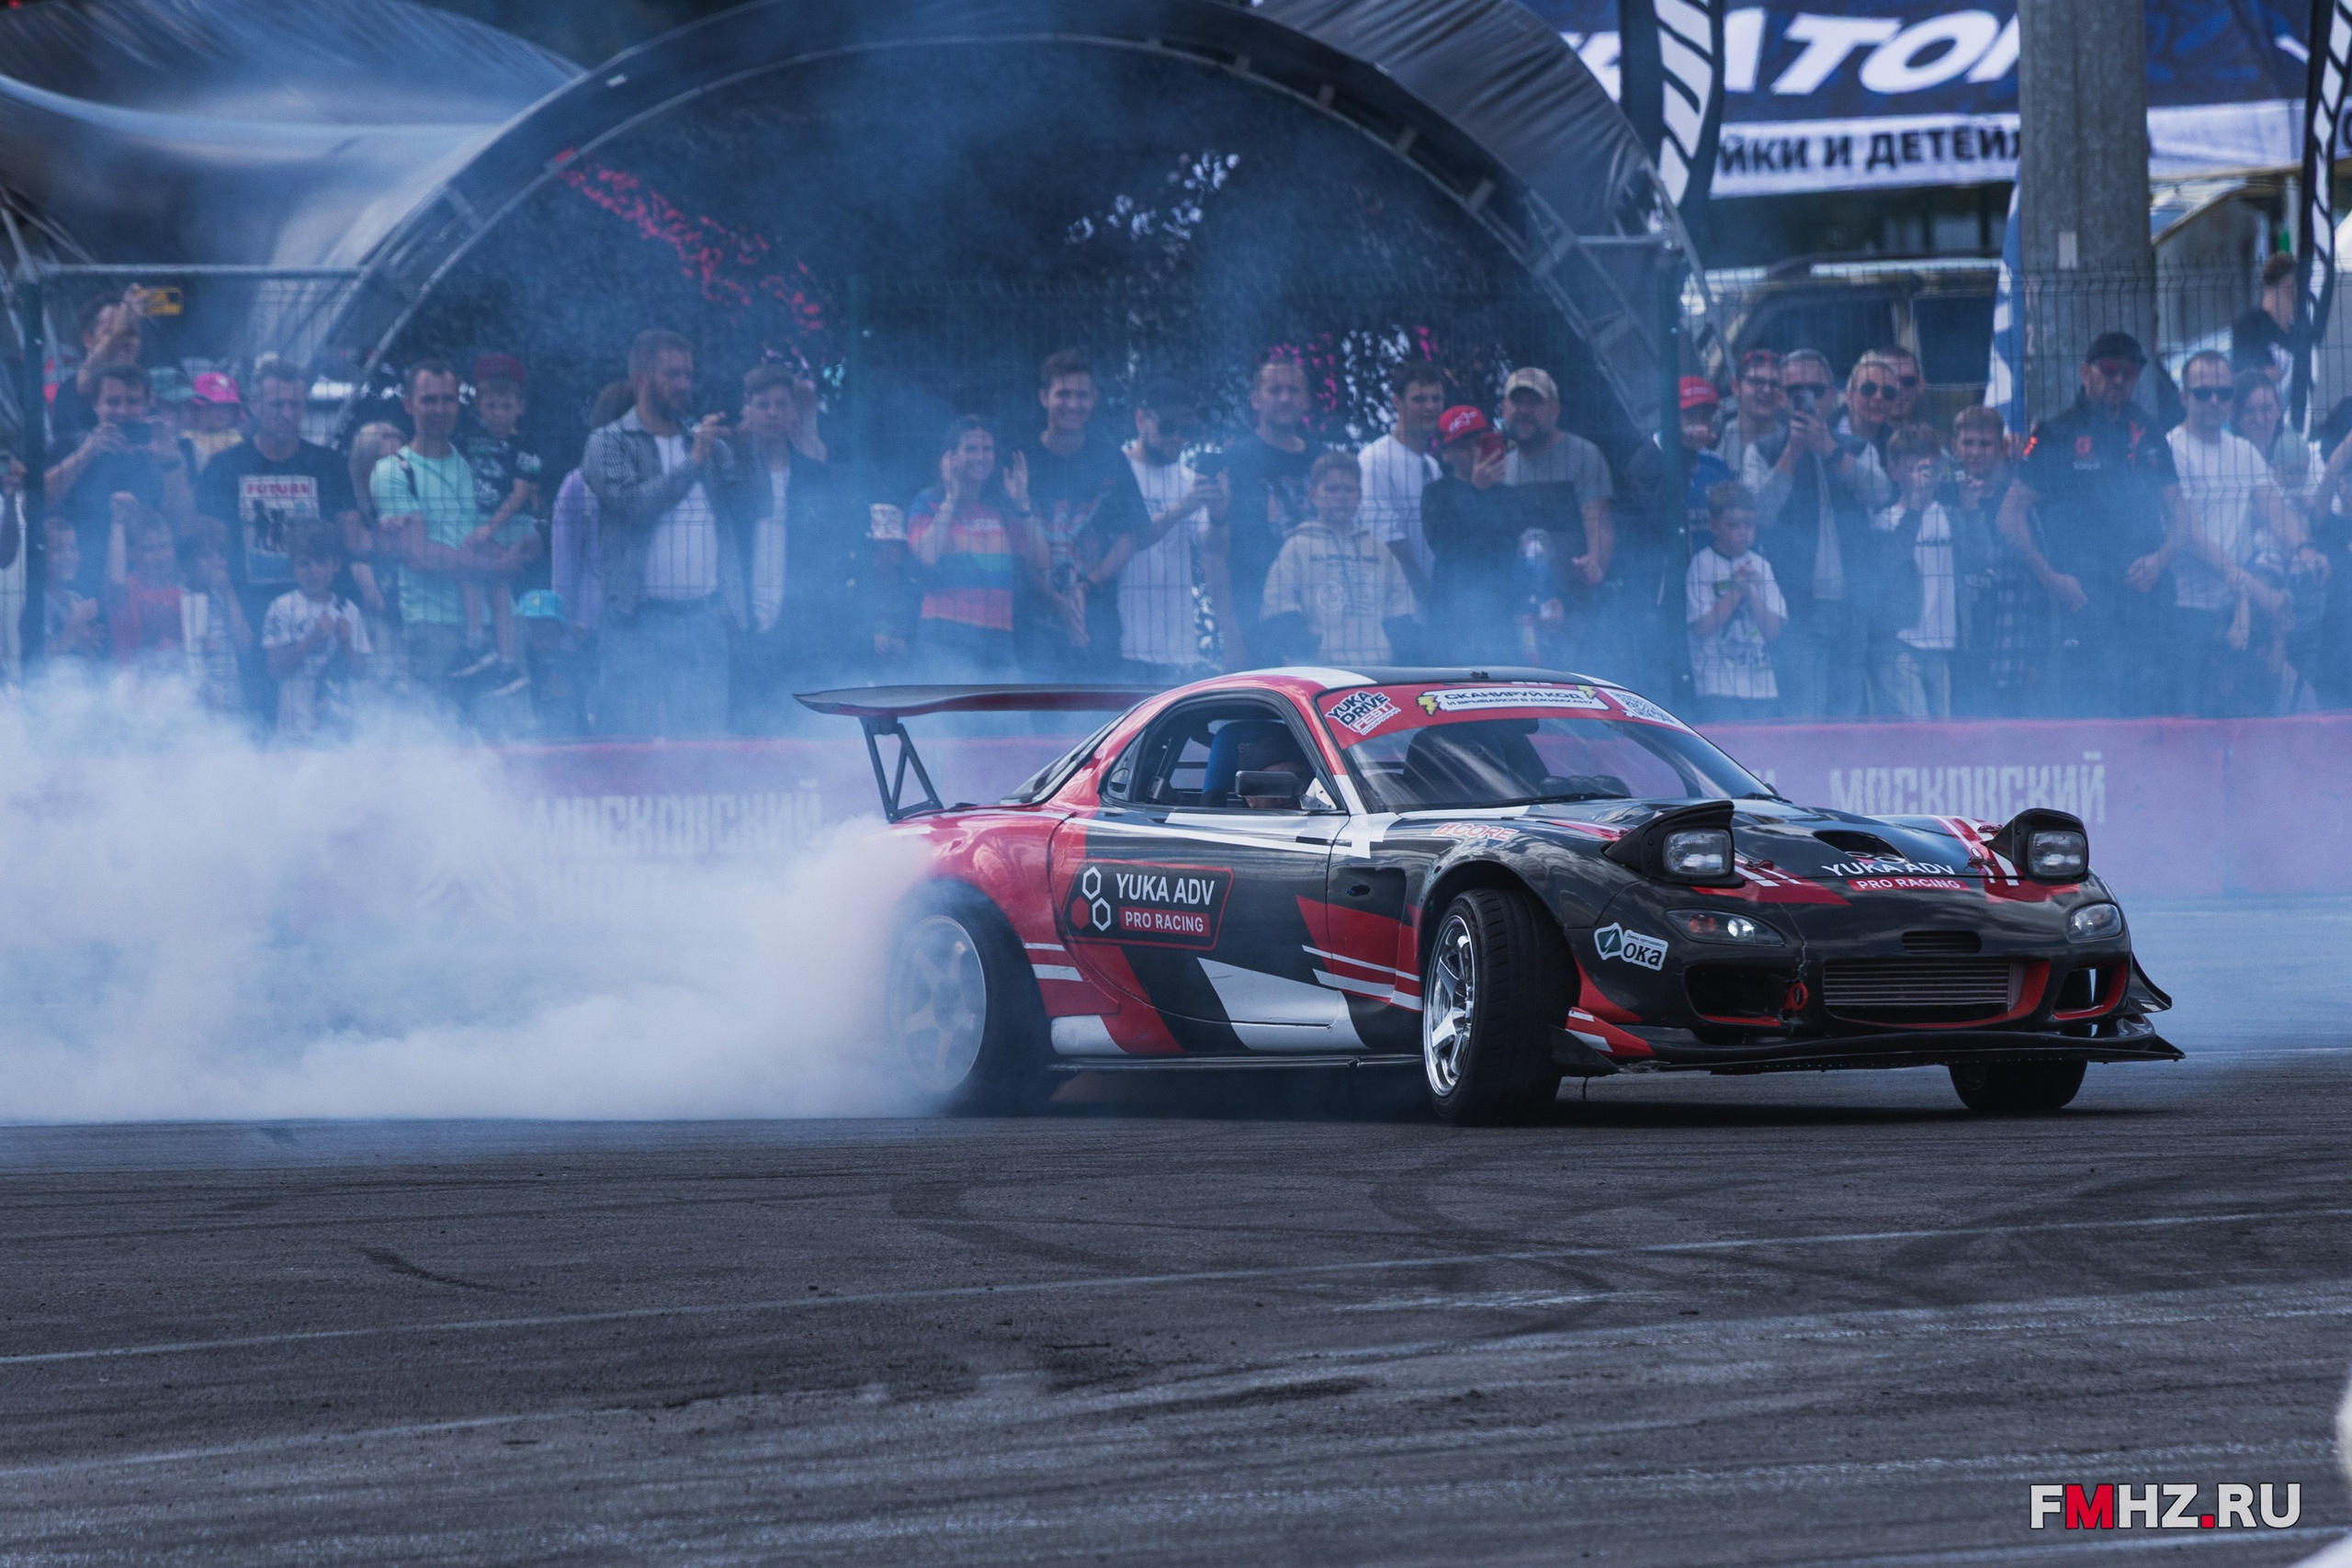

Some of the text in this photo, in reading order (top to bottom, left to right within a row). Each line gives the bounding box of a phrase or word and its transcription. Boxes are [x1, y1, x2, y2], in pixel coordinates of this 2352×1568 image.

[1823, 134, 1852, 168] И
[1328, 692, 1373, 718] YUKA
[1444, 690, 1583, 700] СКАНИРУЙ КОД
[1340, 693, 1389, 726] DRIVE
[1352, 703, 1391, 730] FEST
[1821, 862, 1956, 876] YUKA ADV
[1115, 873, 1215, 906] YUKA ADV
[1856, 878, 1961, 889] PRO RACING
[1125, 911, 1204, 932] PRO RACING
